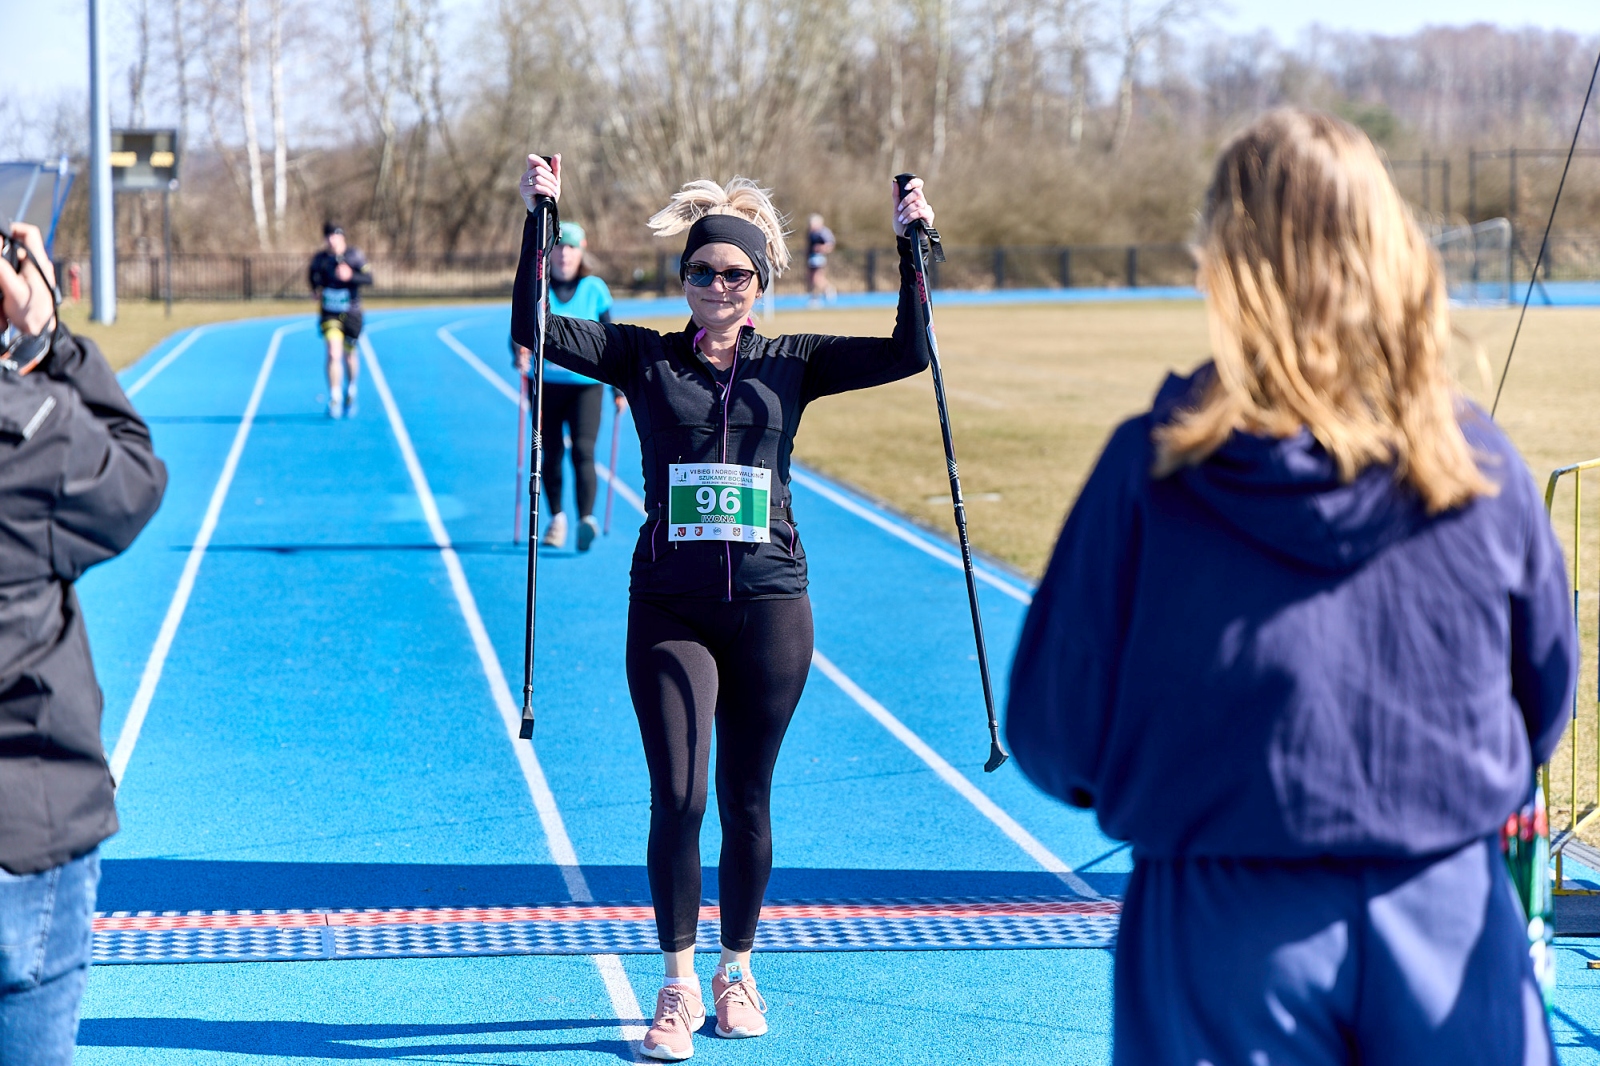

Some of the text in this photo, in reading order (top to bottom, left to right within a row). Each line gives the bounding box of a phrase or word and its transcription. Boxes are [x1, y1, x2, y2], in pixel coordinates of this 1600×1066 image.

[739, 471, 764, 479] WALKING
[695, 486, 740, 514] 96
[701, 515, 735, 523] IWONA
